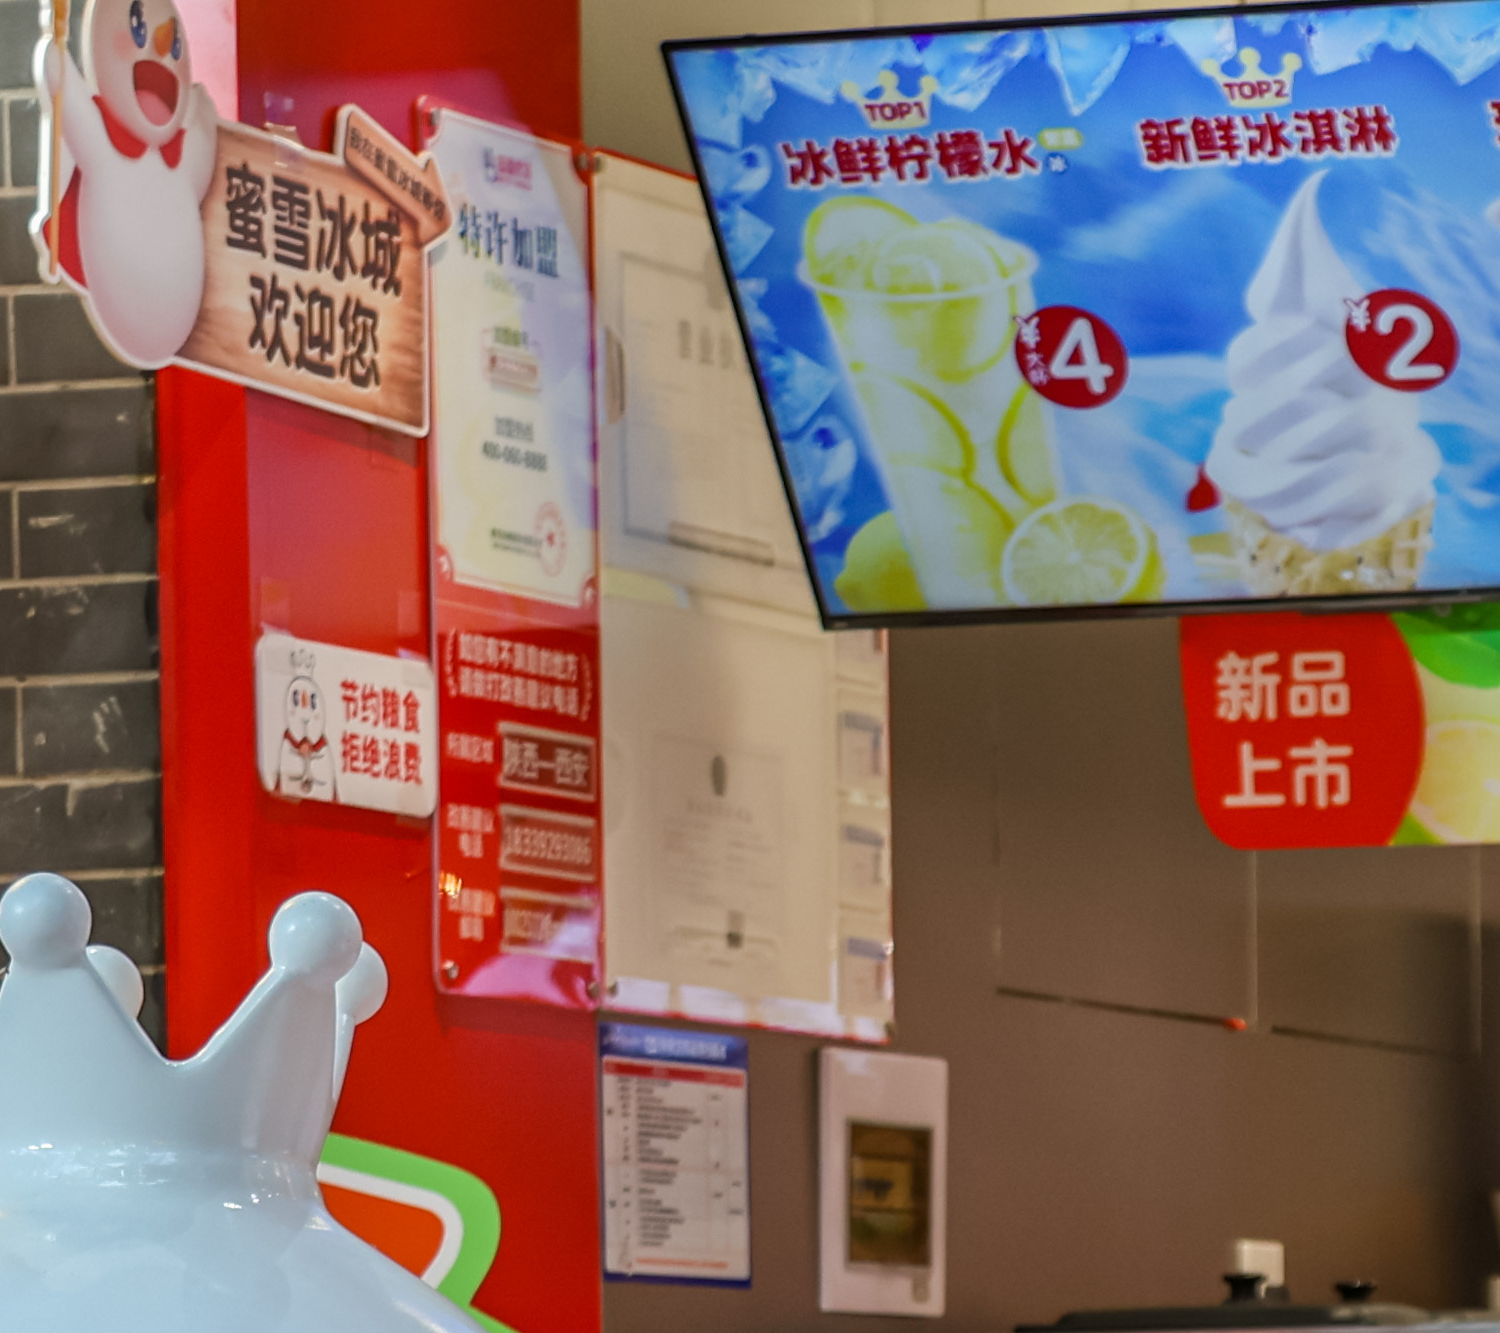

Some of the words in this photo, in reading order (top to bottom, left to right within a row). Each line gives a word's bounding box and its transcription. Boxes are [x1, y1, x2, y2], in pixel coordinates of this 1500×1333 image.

[864, 97, 928, 124] TOP1
[1223, 78, 1290, 104] TOP2
[783, 131, 1039, 187] 冰鲜柠檬水
[1139, 106, 1398, 167] 新鲜冰淇淋
[225, 161, 403, 298] 蜜雪冰城
[458, 203, 560, 280] 特许加盟
[248, 273, 382, 390] 欢迎您
[338, 679, 422, 735] 节约粮食
[1216, 651, 1352, 723] 新品
[338, 729, 424, 787] 拒绝浪费
[1221, 738, 1354, 810] 上市
